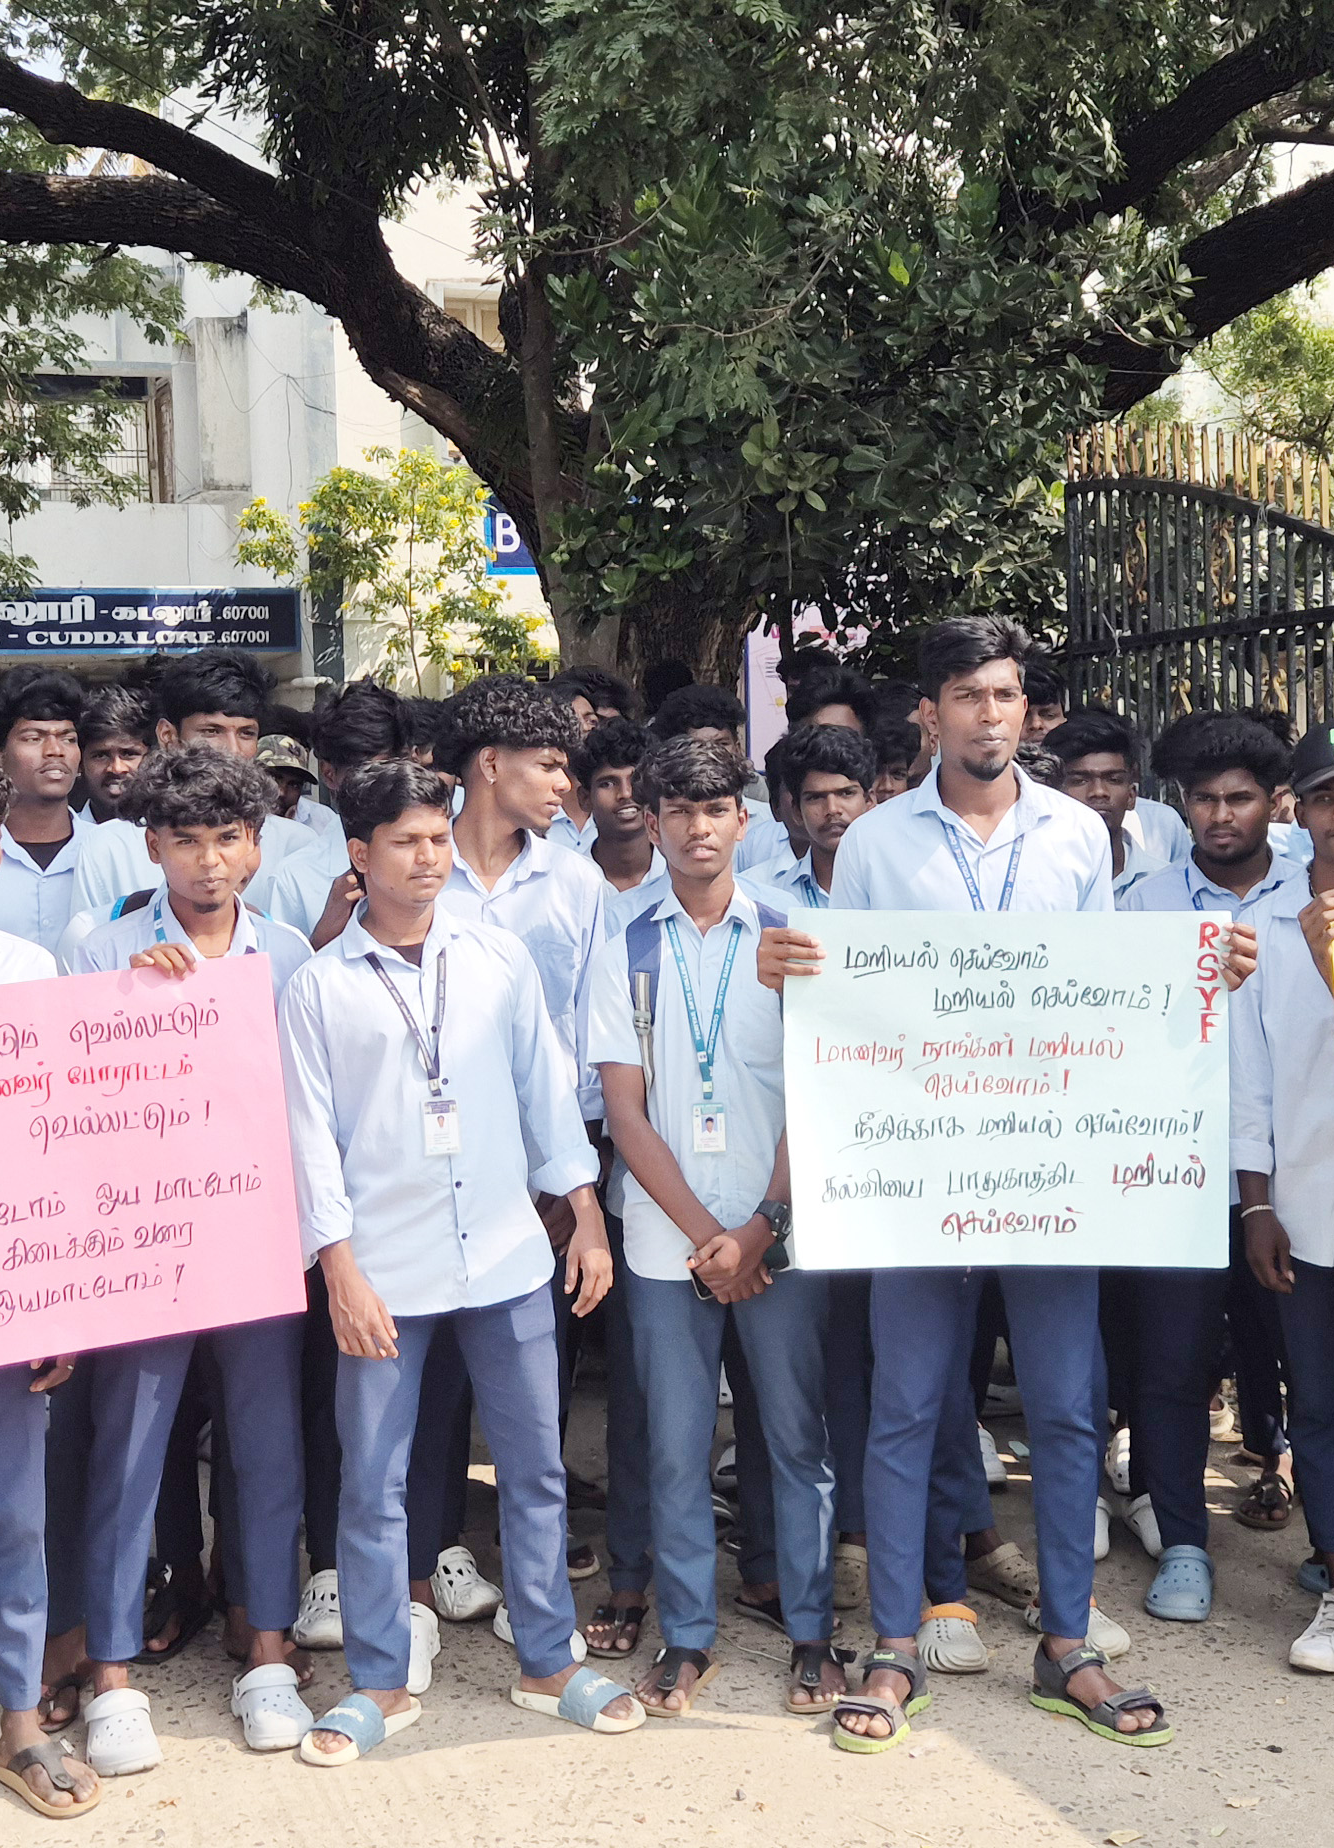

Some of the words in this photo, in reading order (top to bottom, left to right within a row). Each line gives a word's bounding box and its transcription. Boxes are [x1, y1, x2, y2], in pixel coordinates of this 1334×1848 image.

[496, 512, 520, 553] B
[843, 941, 938, 979] மறியல்
[950, 943, 1048, 978] செய்வோம்
[933, 980, 1015, 1018] மறியல்
[1194, 921, 1221, 1043] RSYF
[70, 998, 219, 1055] வெல்லட்டும்
[815, 1034, 905, 1072] மாணவர்
[912, 1032, 1013, 1071] நாங்கள்
[1029, 1027, 1123, 1062] மறியல்
[976, 1110, 1062, 1141] மறியல்
[1112, 1152, 1205, 1196] மறியல்
[941, 1206, 1083, 1243] செய்வோம்
